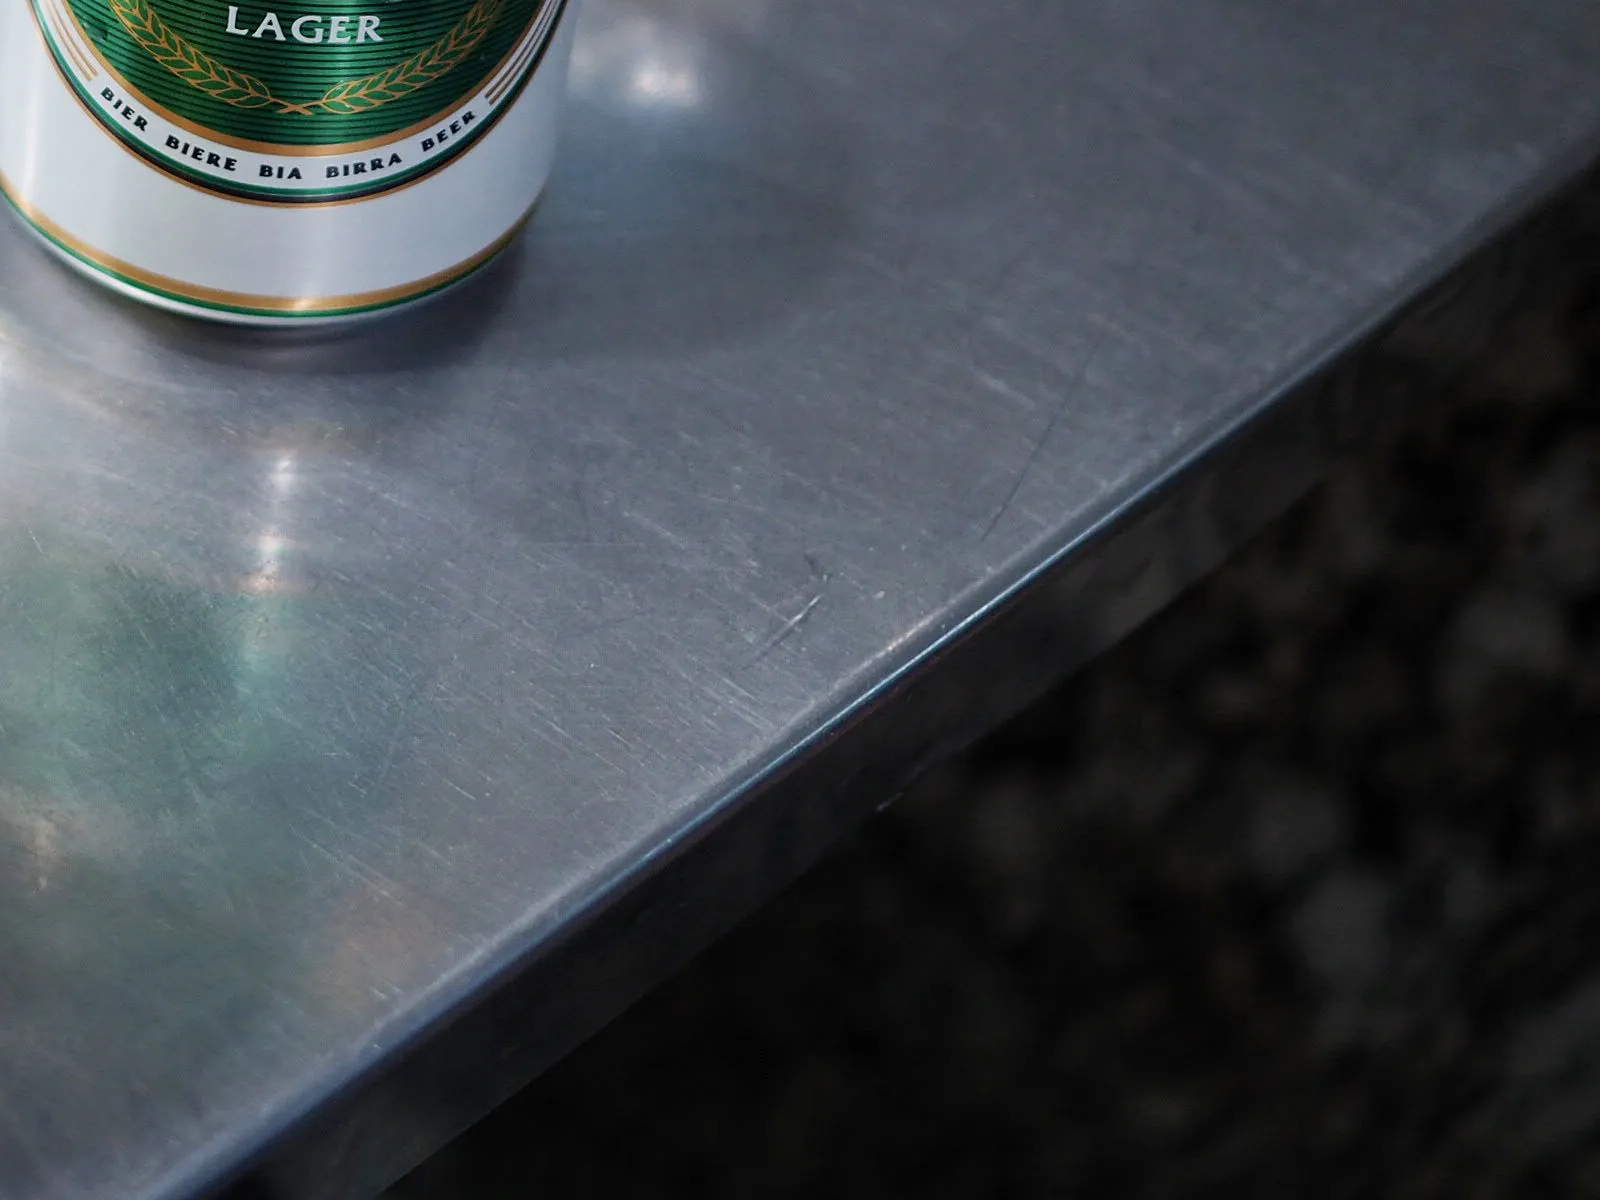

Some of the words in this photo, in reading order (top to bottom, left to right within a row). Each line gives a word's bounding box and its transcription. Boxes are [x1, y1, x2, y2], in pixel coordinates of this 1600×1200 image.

[225, 6, 384, 44] LAGER
[100, 86, 149, 133] BIER
[164, 134, 238, 172] BIERE
[258, 164, 303, 180] BIA
[325, 152, 403, 179] BIRRA
[419, 110, 477, 153] BEER
